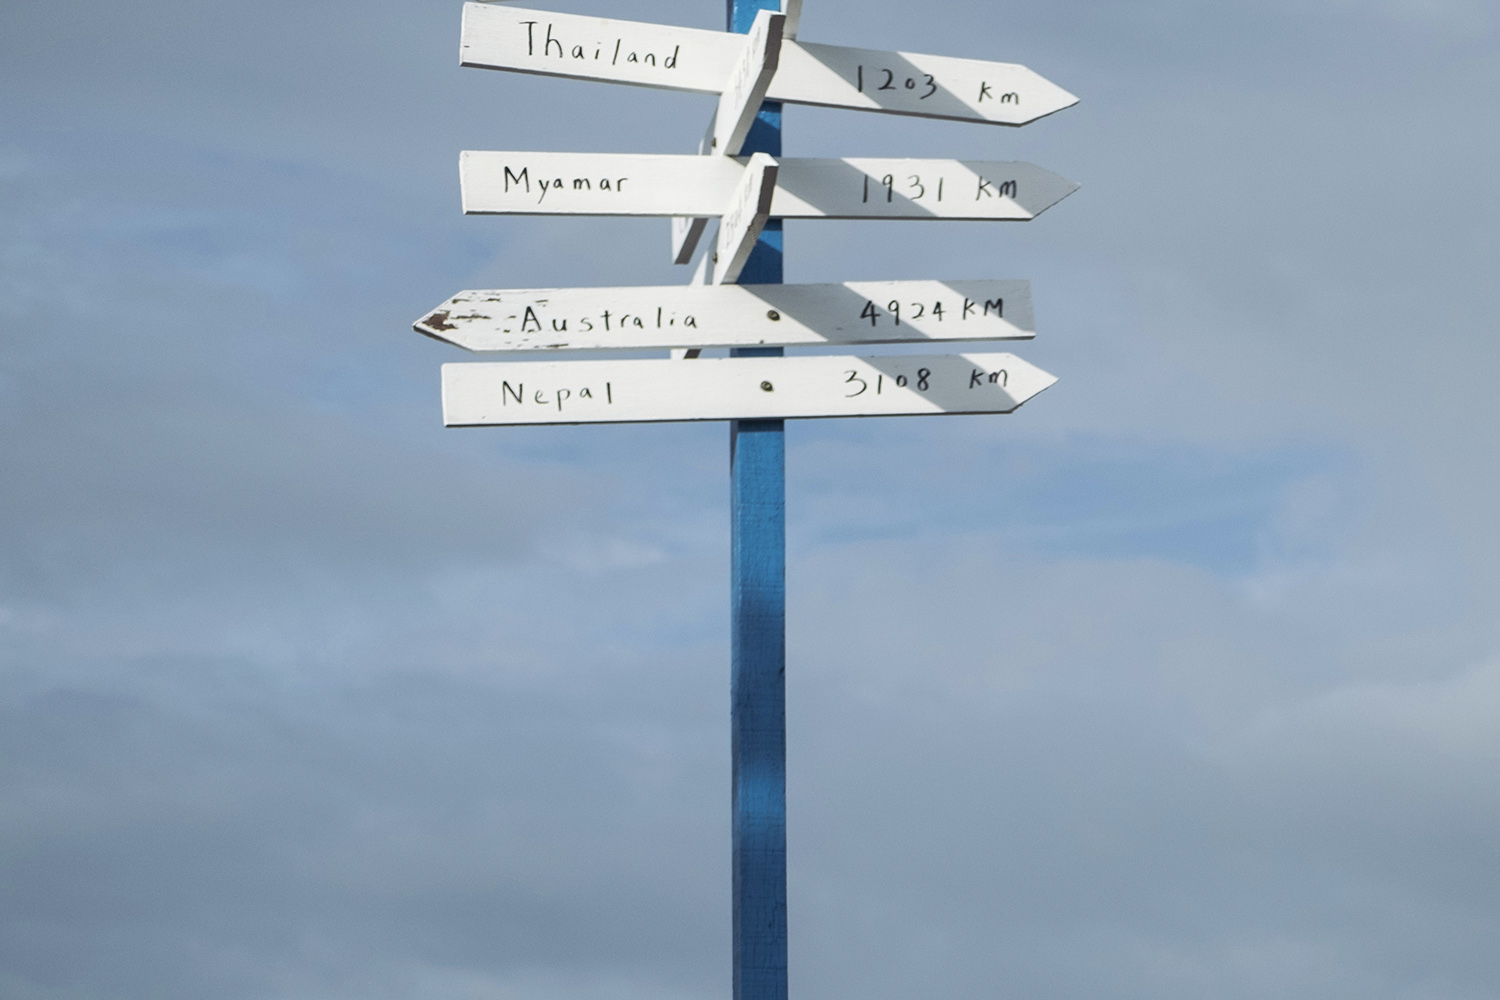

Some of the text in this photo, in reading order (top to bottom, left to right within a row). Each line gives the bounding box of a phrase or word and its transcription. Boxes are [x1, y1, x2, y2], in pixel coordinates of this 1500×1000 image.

[519, 21, 680, 69] Thailand
[857, 64, 938, 100] 1203
[503, 165, 629, 204] Myamar
[862, 173, 944, 204] 1931
[520, 305, 699, 332] Australia
[859, 299, 947, 328] 4924
[501, 380, 613, 412] Nepal
[843, 366, 932, 398] 3108
